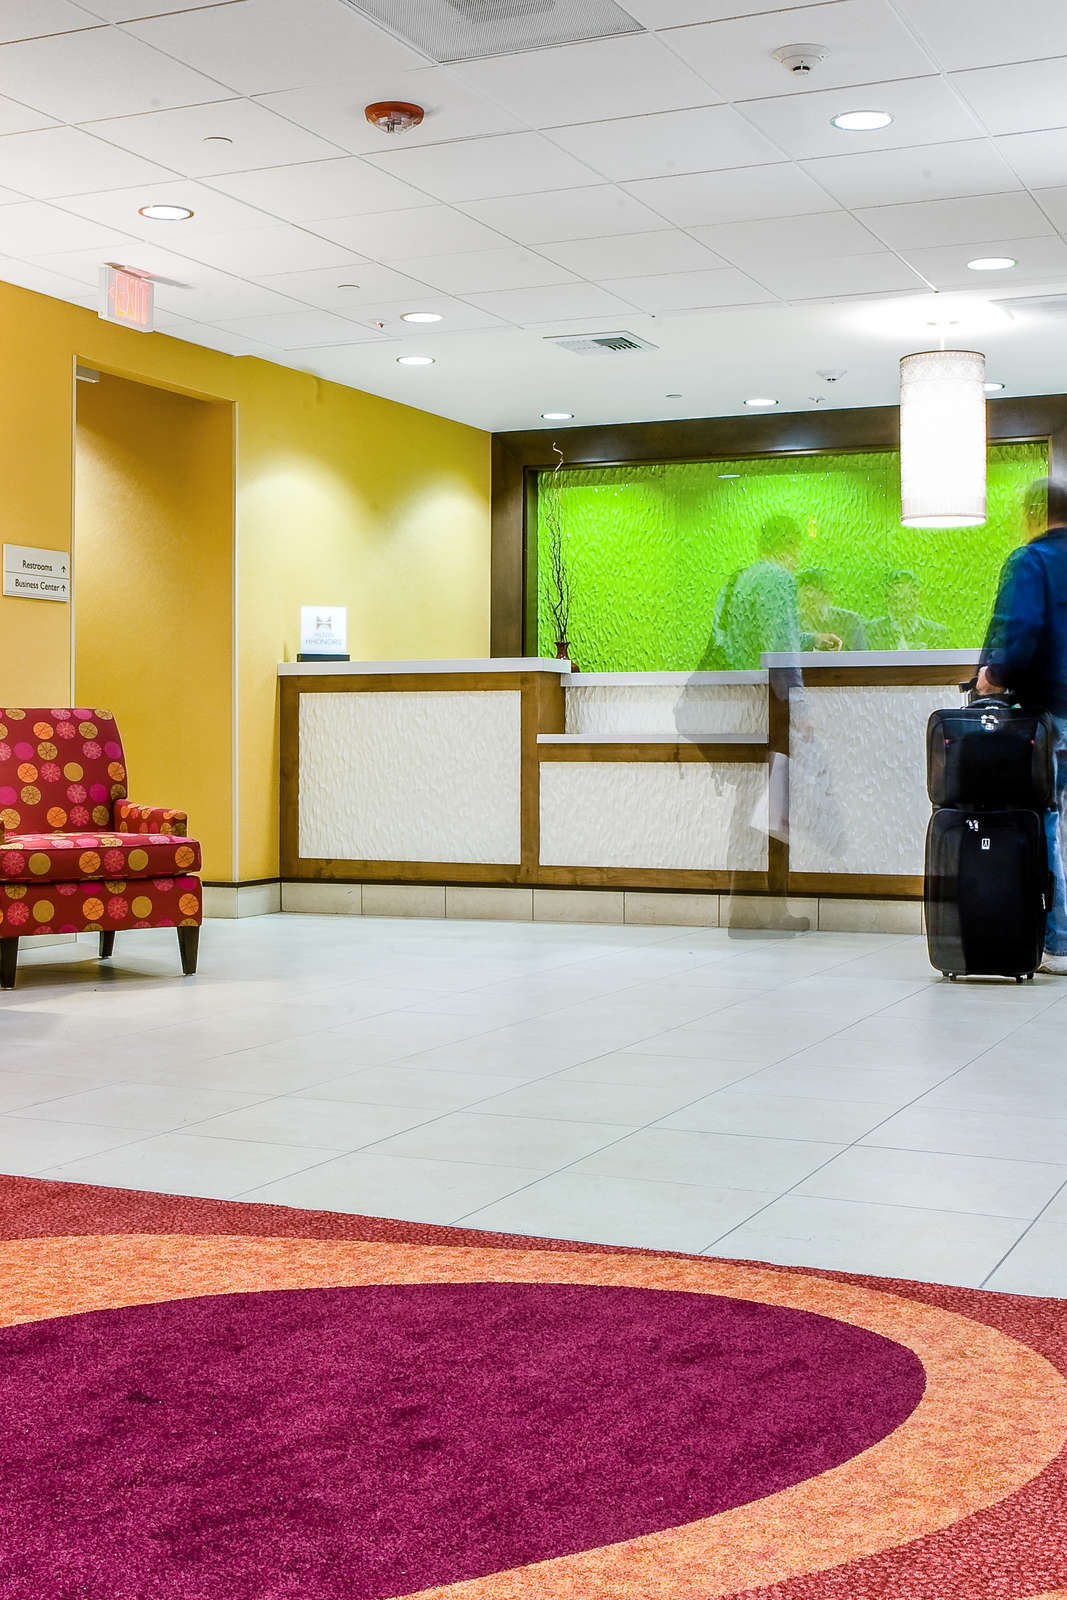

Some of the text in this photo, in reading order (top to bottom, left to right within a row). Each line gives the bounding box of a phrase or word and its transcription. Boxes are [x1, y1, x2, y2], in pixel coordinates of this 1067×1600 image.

[115, 274, 150, 324] EXIT
[22, 559, 53, 571] Restrooms
[15, 578, 60, 592] Business Center
